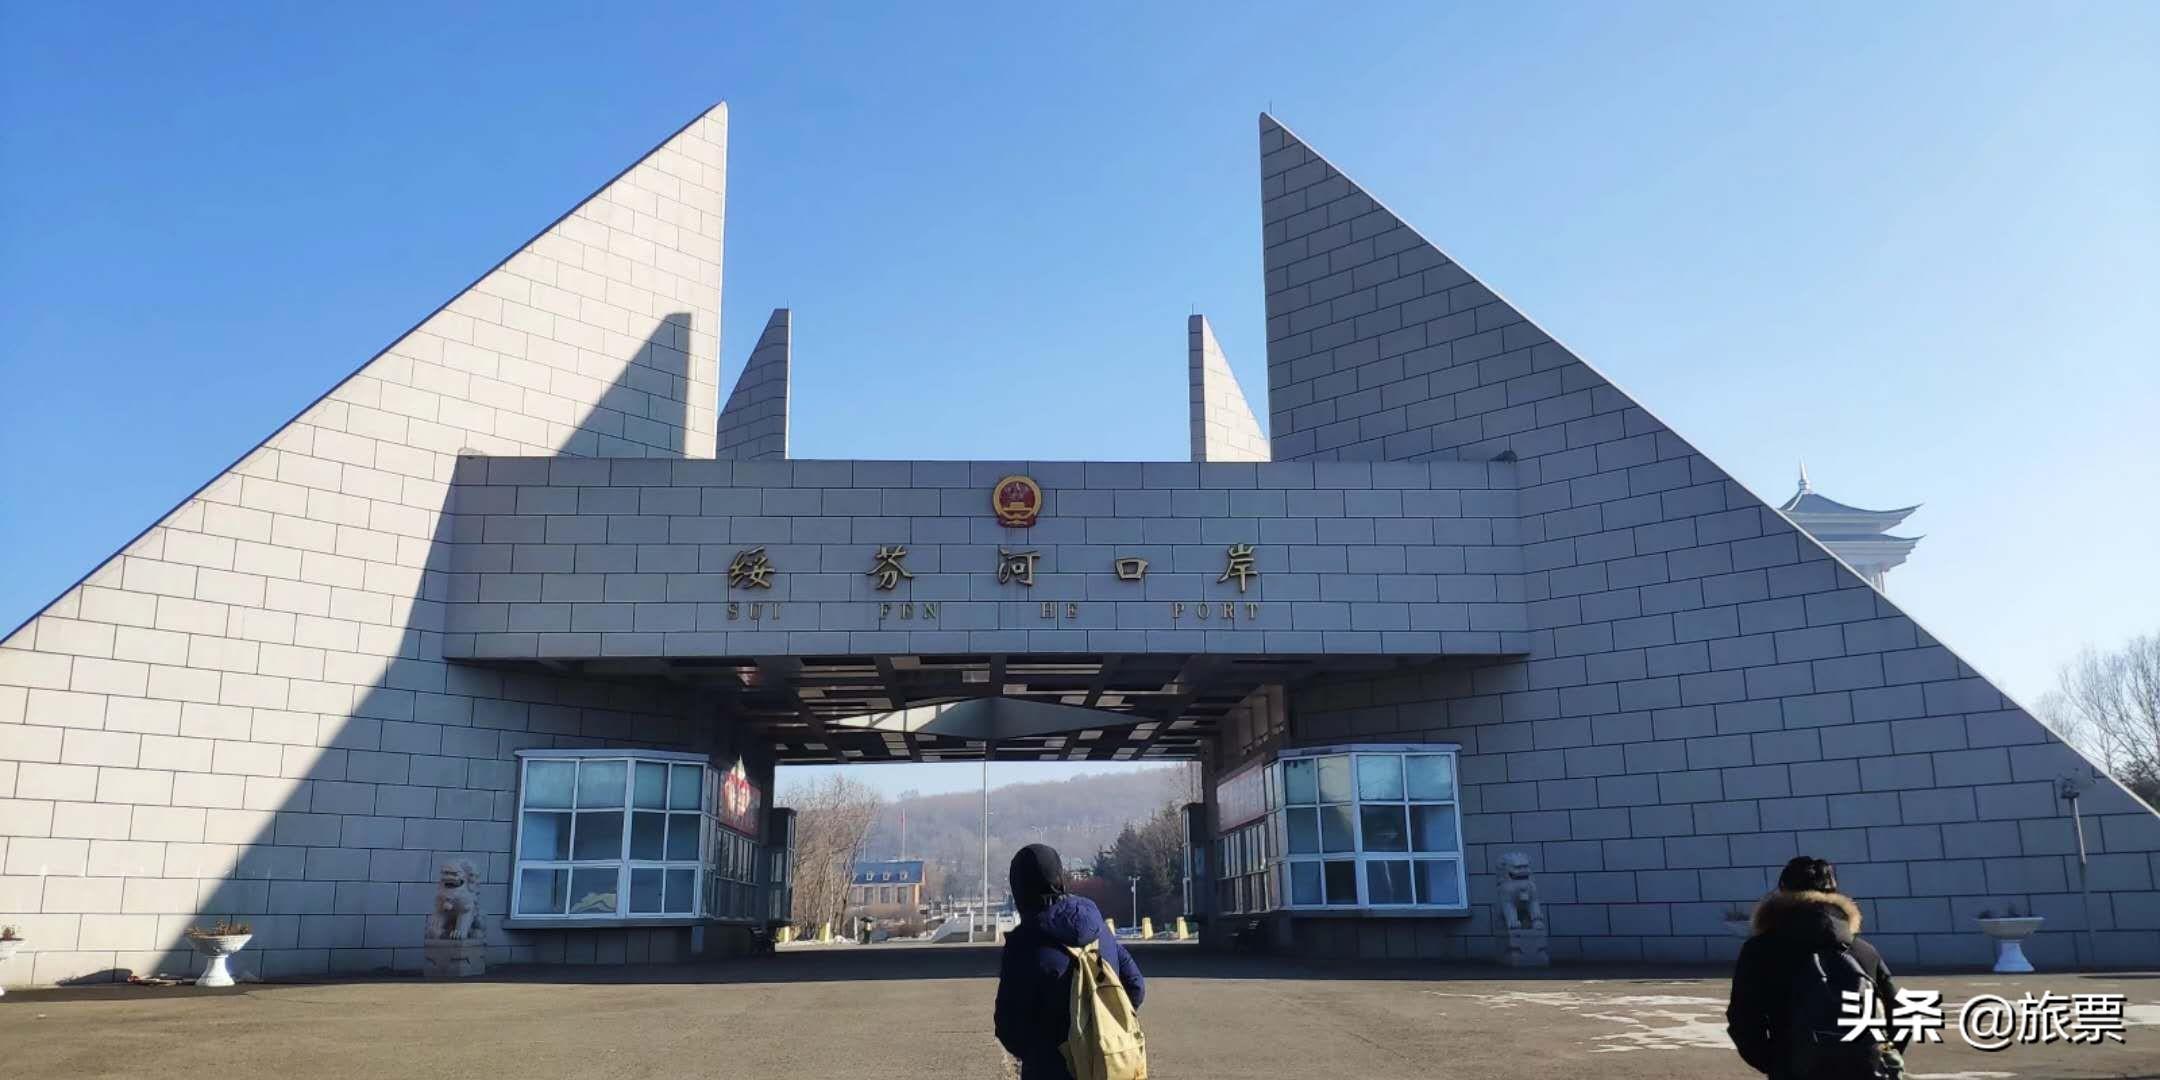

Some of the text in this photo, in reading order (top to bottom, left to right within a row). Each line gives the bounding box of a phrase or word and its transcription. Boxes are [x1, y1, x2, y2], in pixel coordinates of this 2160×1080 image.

[728, 544, 1258, 593] 绥芬河口岸
[727, 602, 1262, 620] SUI FEN HE PORT
